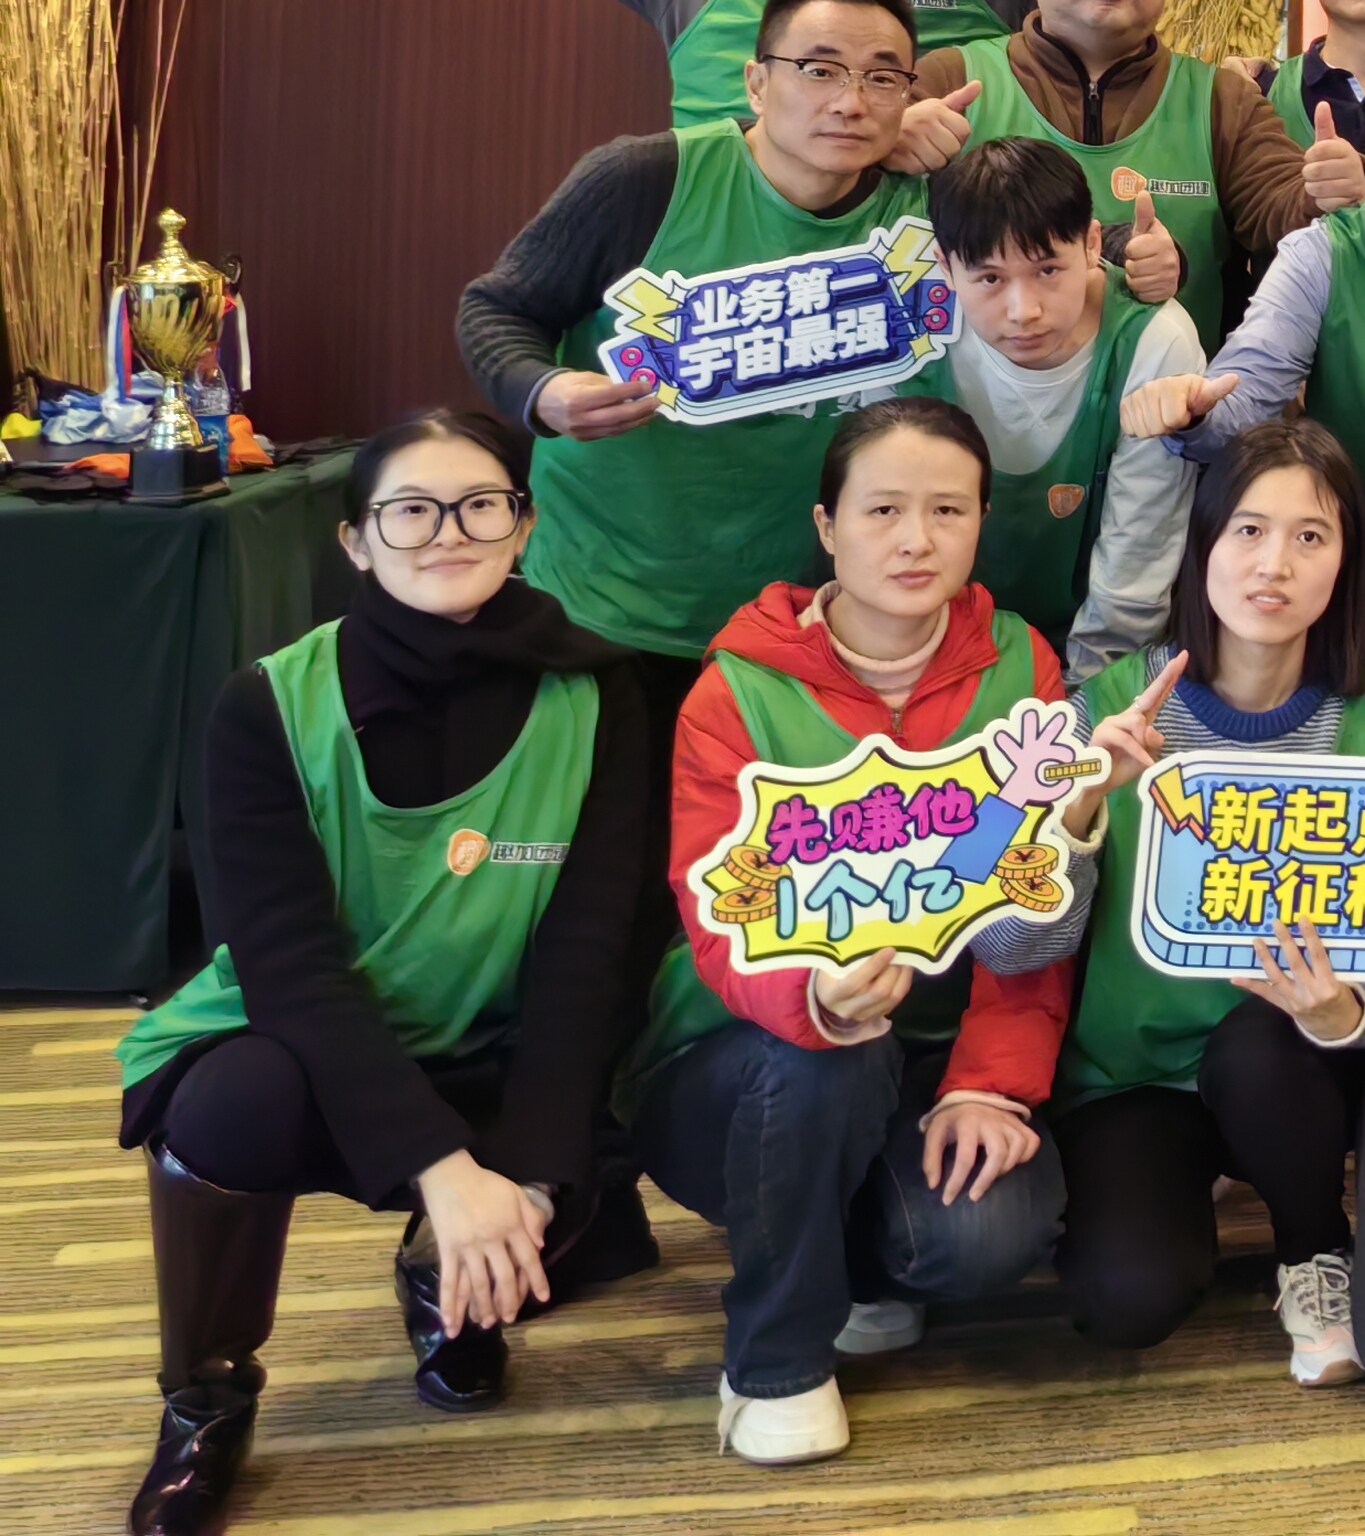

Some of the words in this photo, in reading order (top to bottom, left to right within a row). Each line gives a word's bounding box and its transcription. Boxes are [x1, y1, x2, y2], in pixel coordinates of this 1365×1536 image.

[691, 267, 878, 336] 业务第一
[678, 303, 889, 390] 宇宙最强
[768, 778, 978, 864] 先赚他
